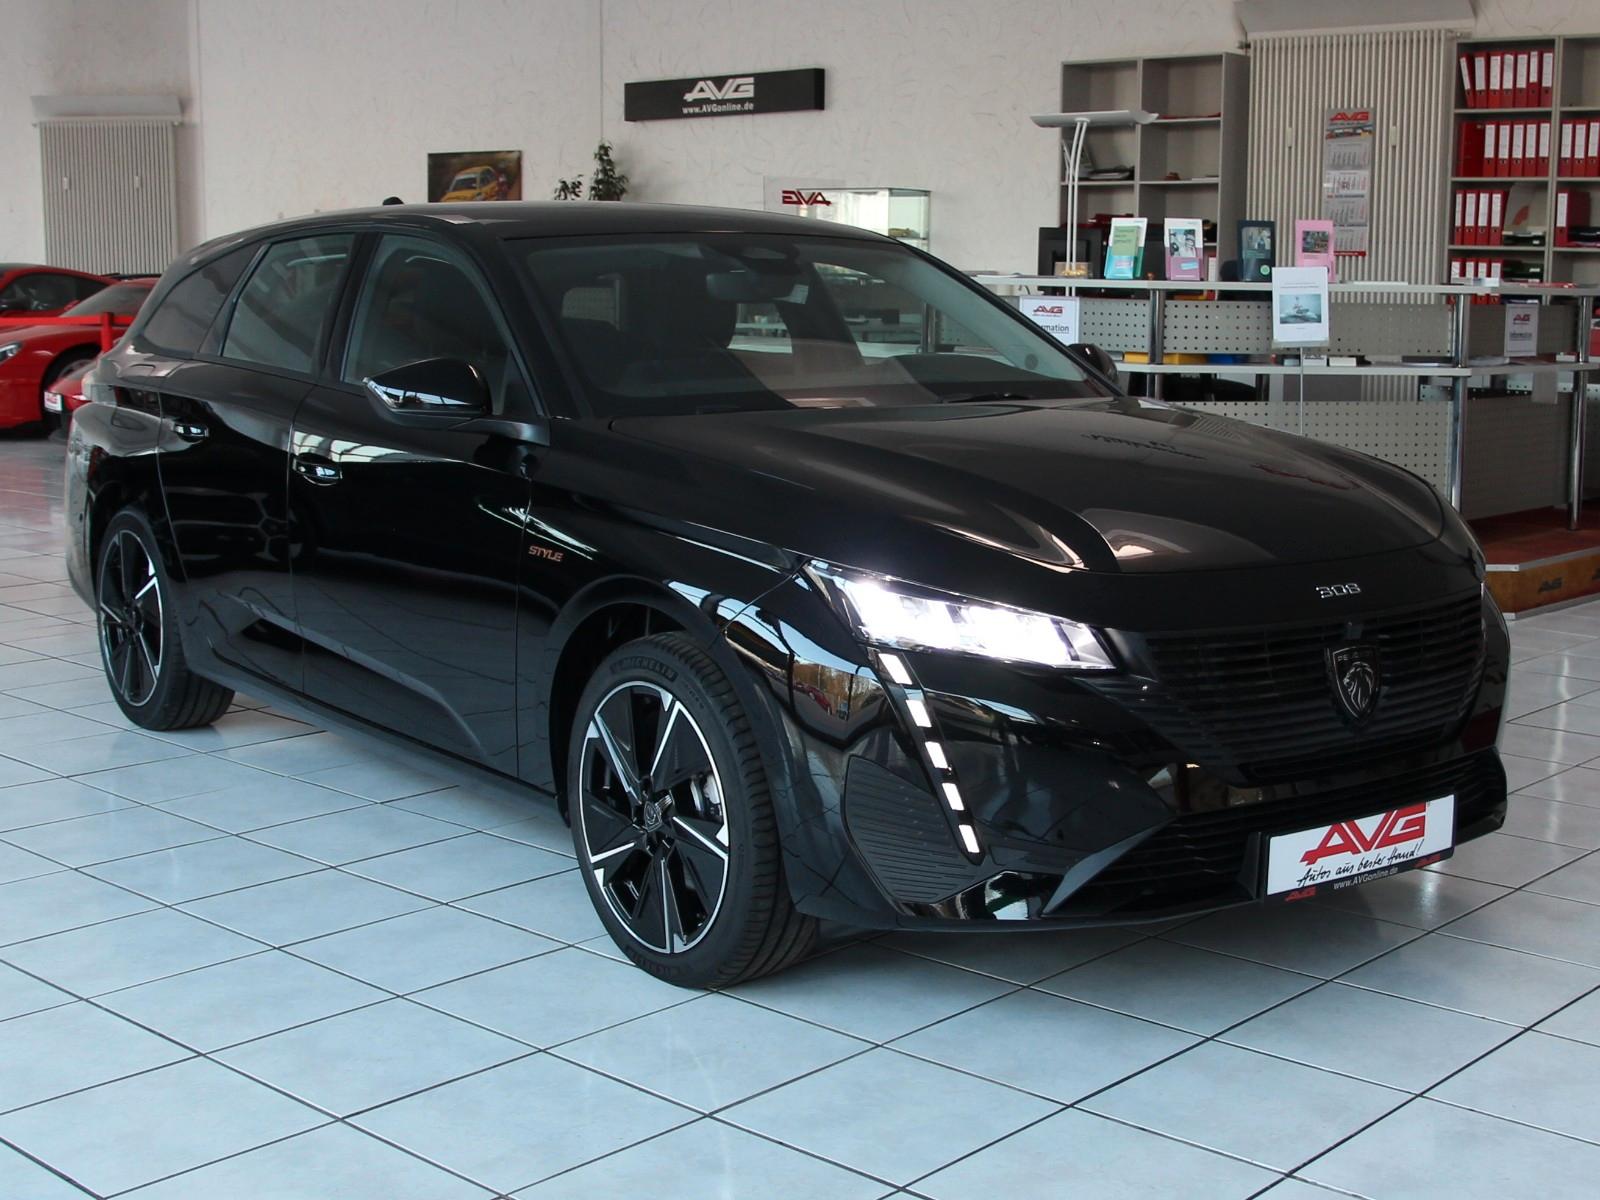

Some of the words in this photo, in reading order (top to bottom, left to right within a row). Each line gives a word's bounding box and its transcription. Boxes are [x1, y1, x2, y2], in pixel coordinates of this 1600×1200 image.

[683, 77, 755, 102] AVG
[682, 101, 754, 114] www.AVGonline.de
[1033, 305, 1063, 314] AVG
[528, 545, 563, 562] STYLE
[1316, 583, 1361, 598] 308
[1300, 802, 1426, 866] AVG
[1333, 866, 1399, 889] www.AVGonline.de
